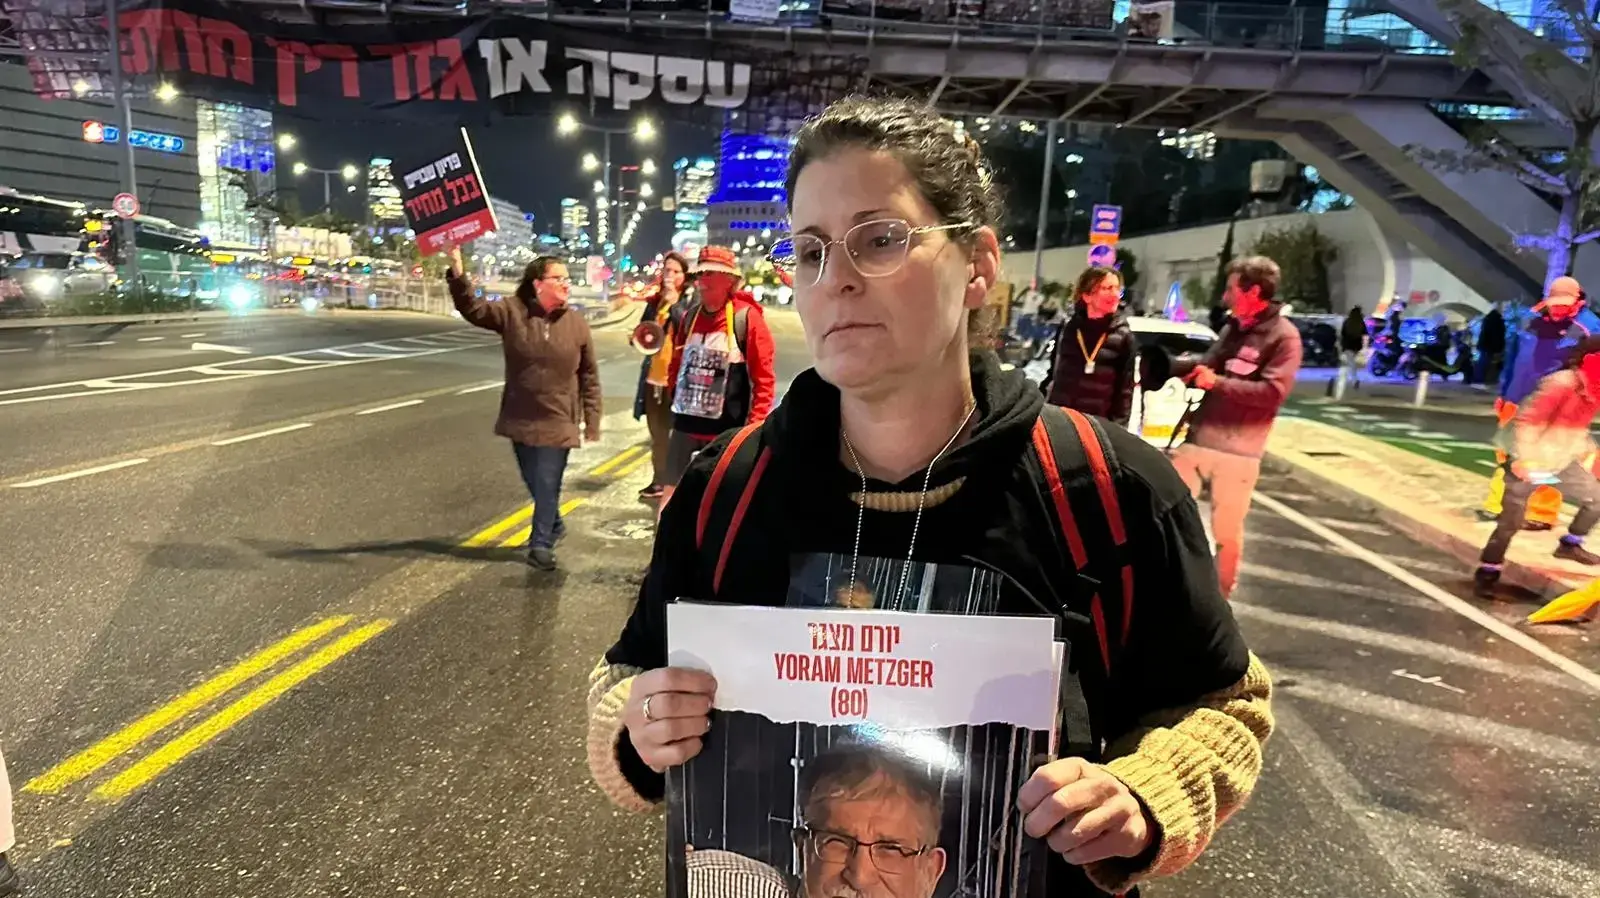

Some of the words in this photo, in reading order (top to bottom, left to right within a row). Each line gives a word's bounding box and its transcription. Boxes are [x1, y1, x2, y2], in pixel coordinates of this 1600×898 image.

[264, 35, 360, 107] דין
[366, 37, 478, 102] גזר
[477, 37, 552, 99] או
[564, 46, 752, 110] עסקה
[405, 187, 449, 221] מחיר
[444, 172, 482, 207] בכל
[807, 622, 855, 651] מצגר
[861, 624, 900, 653] יורם
[774, 652, 841, 683] YORAM
[846, 657, 934, 688] METZGER
[831, 686, 868, 719] (80)
